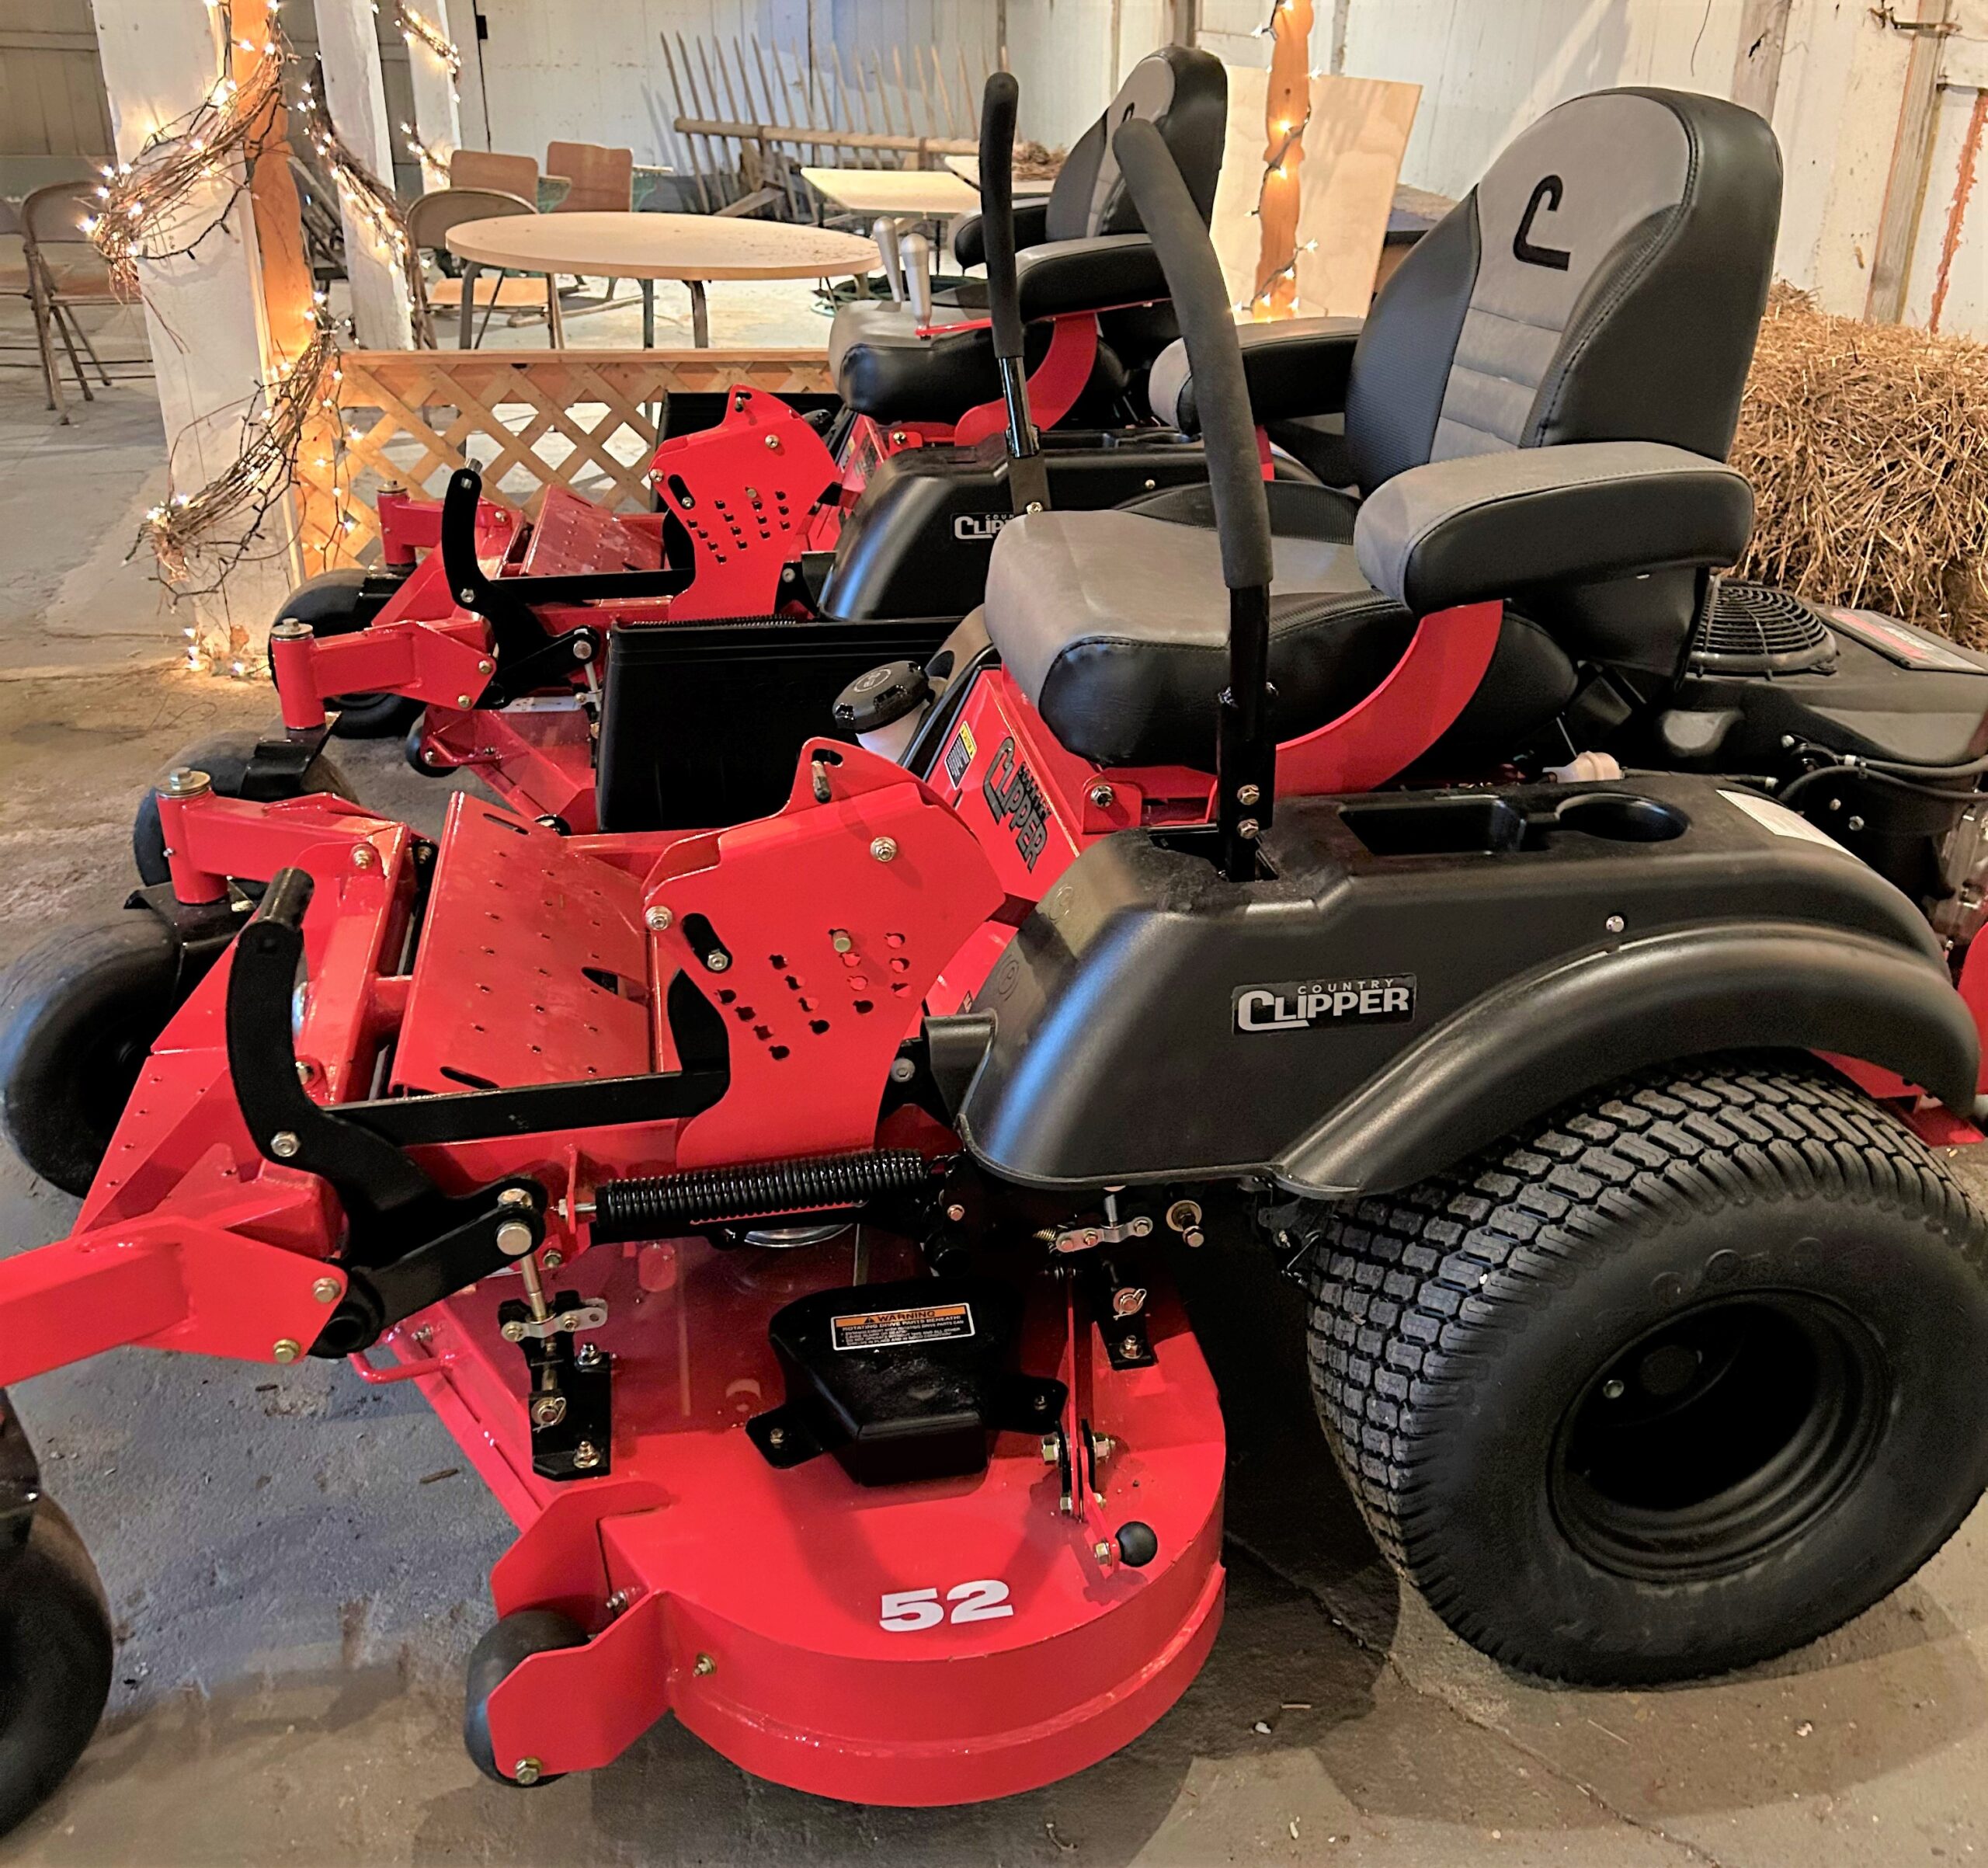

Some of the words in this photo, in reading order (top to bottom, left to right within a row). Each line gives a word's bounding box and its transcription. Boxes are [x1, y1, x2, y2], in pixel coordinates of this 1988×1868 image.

[954, 516, 1011, 540] CLIP
[982, 736, 1048, 875] CLIPPER
[1297, 979, 1394, 995] COUNTRY
[1238, 986, 1410, 1031] CLIPPER
[878, 1310, 936, 1322] WARNING
[879, 1580, 1013, 1632] 52
